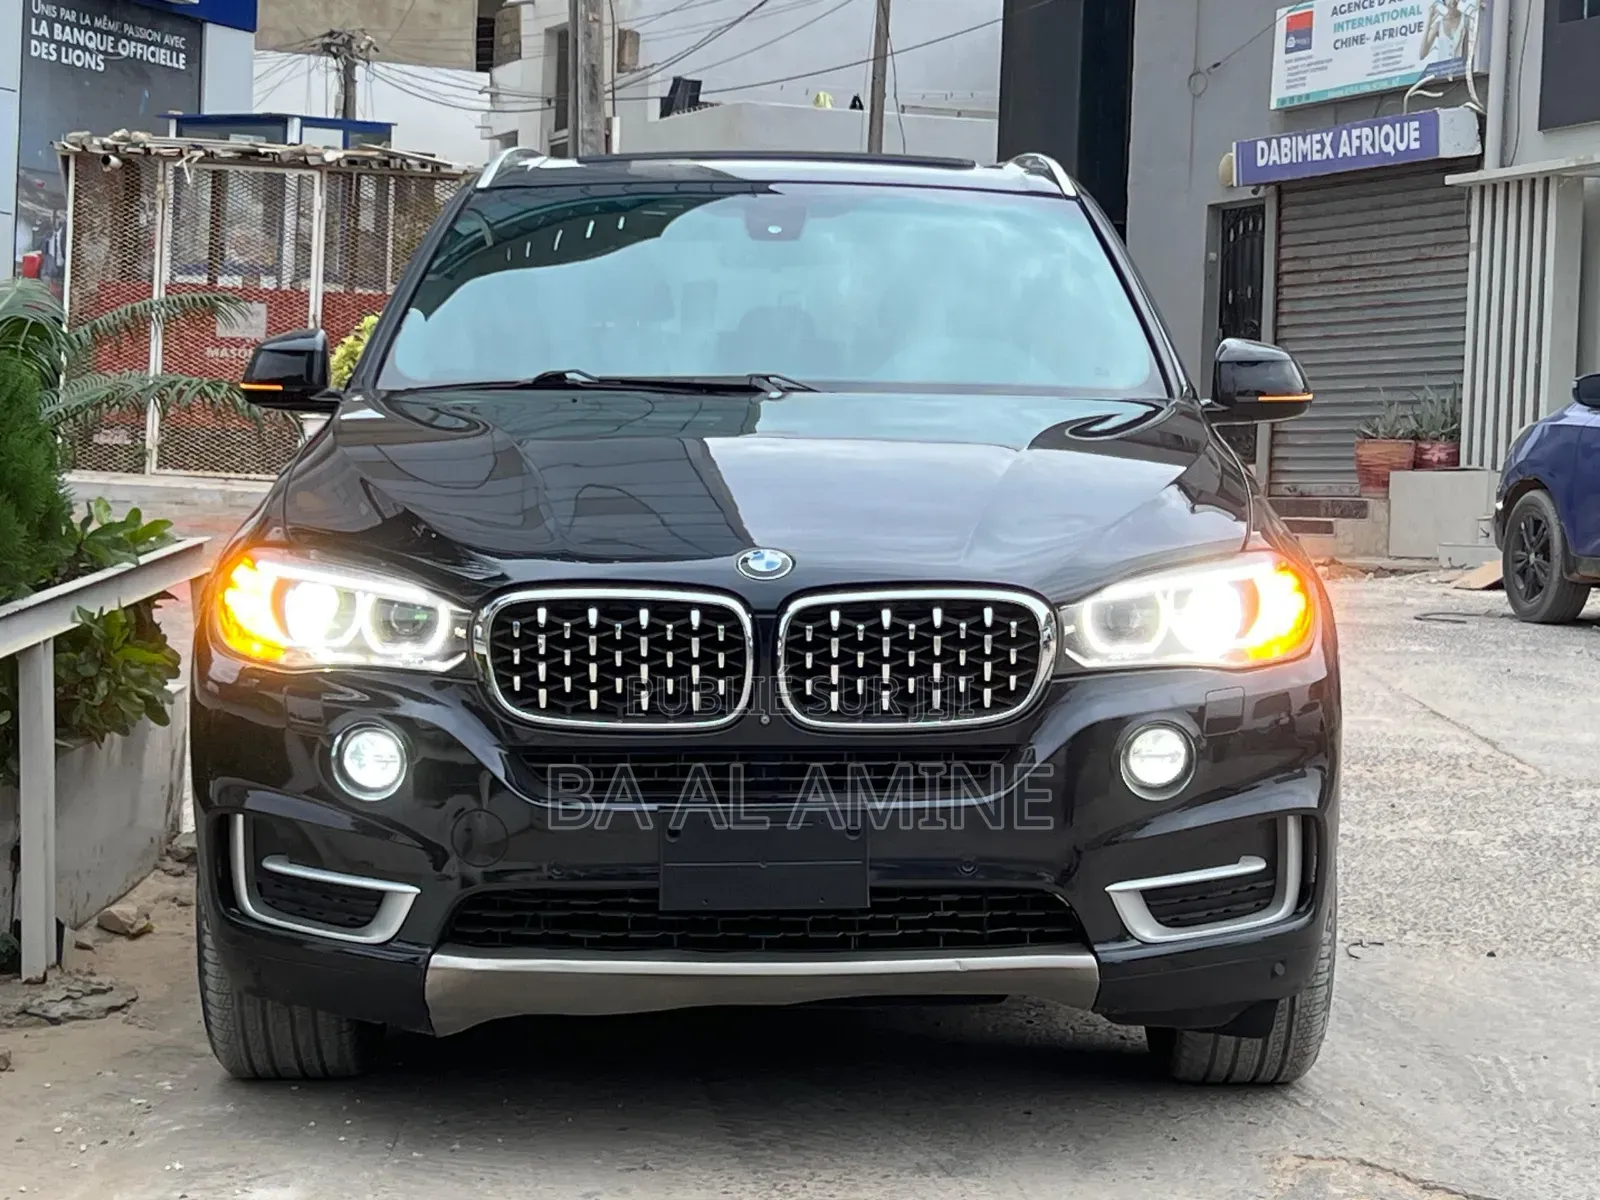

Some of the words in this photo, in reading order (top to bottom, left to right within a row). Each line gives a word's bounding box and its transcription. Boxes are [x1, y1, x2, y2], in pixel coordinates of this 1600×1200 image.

[1331, 0, 1375, 17] AGENCE
[1333, 4, 1423, 34] INTERNATIONAL
[31, 18, 50, 39] LA
[53, 23, 115, 52] BANQUE
[118, 39, 187, 70] OFFICIELLE
[60, 7, 77, 23] PAR
[80, 12, 91, 26] LA
[123, 23, 161, 43] PASSION
[163, 34, 186, 49] AVEC
[1374, 21, 1424, 42] AFRIQUE
[30, 39, 58, 62] DES
[61, 46, 105, 72] LIONS
[1256, 131, 1334, 167] DABIMEX
[1338, 121, 1420, 157] AFRIQUE
